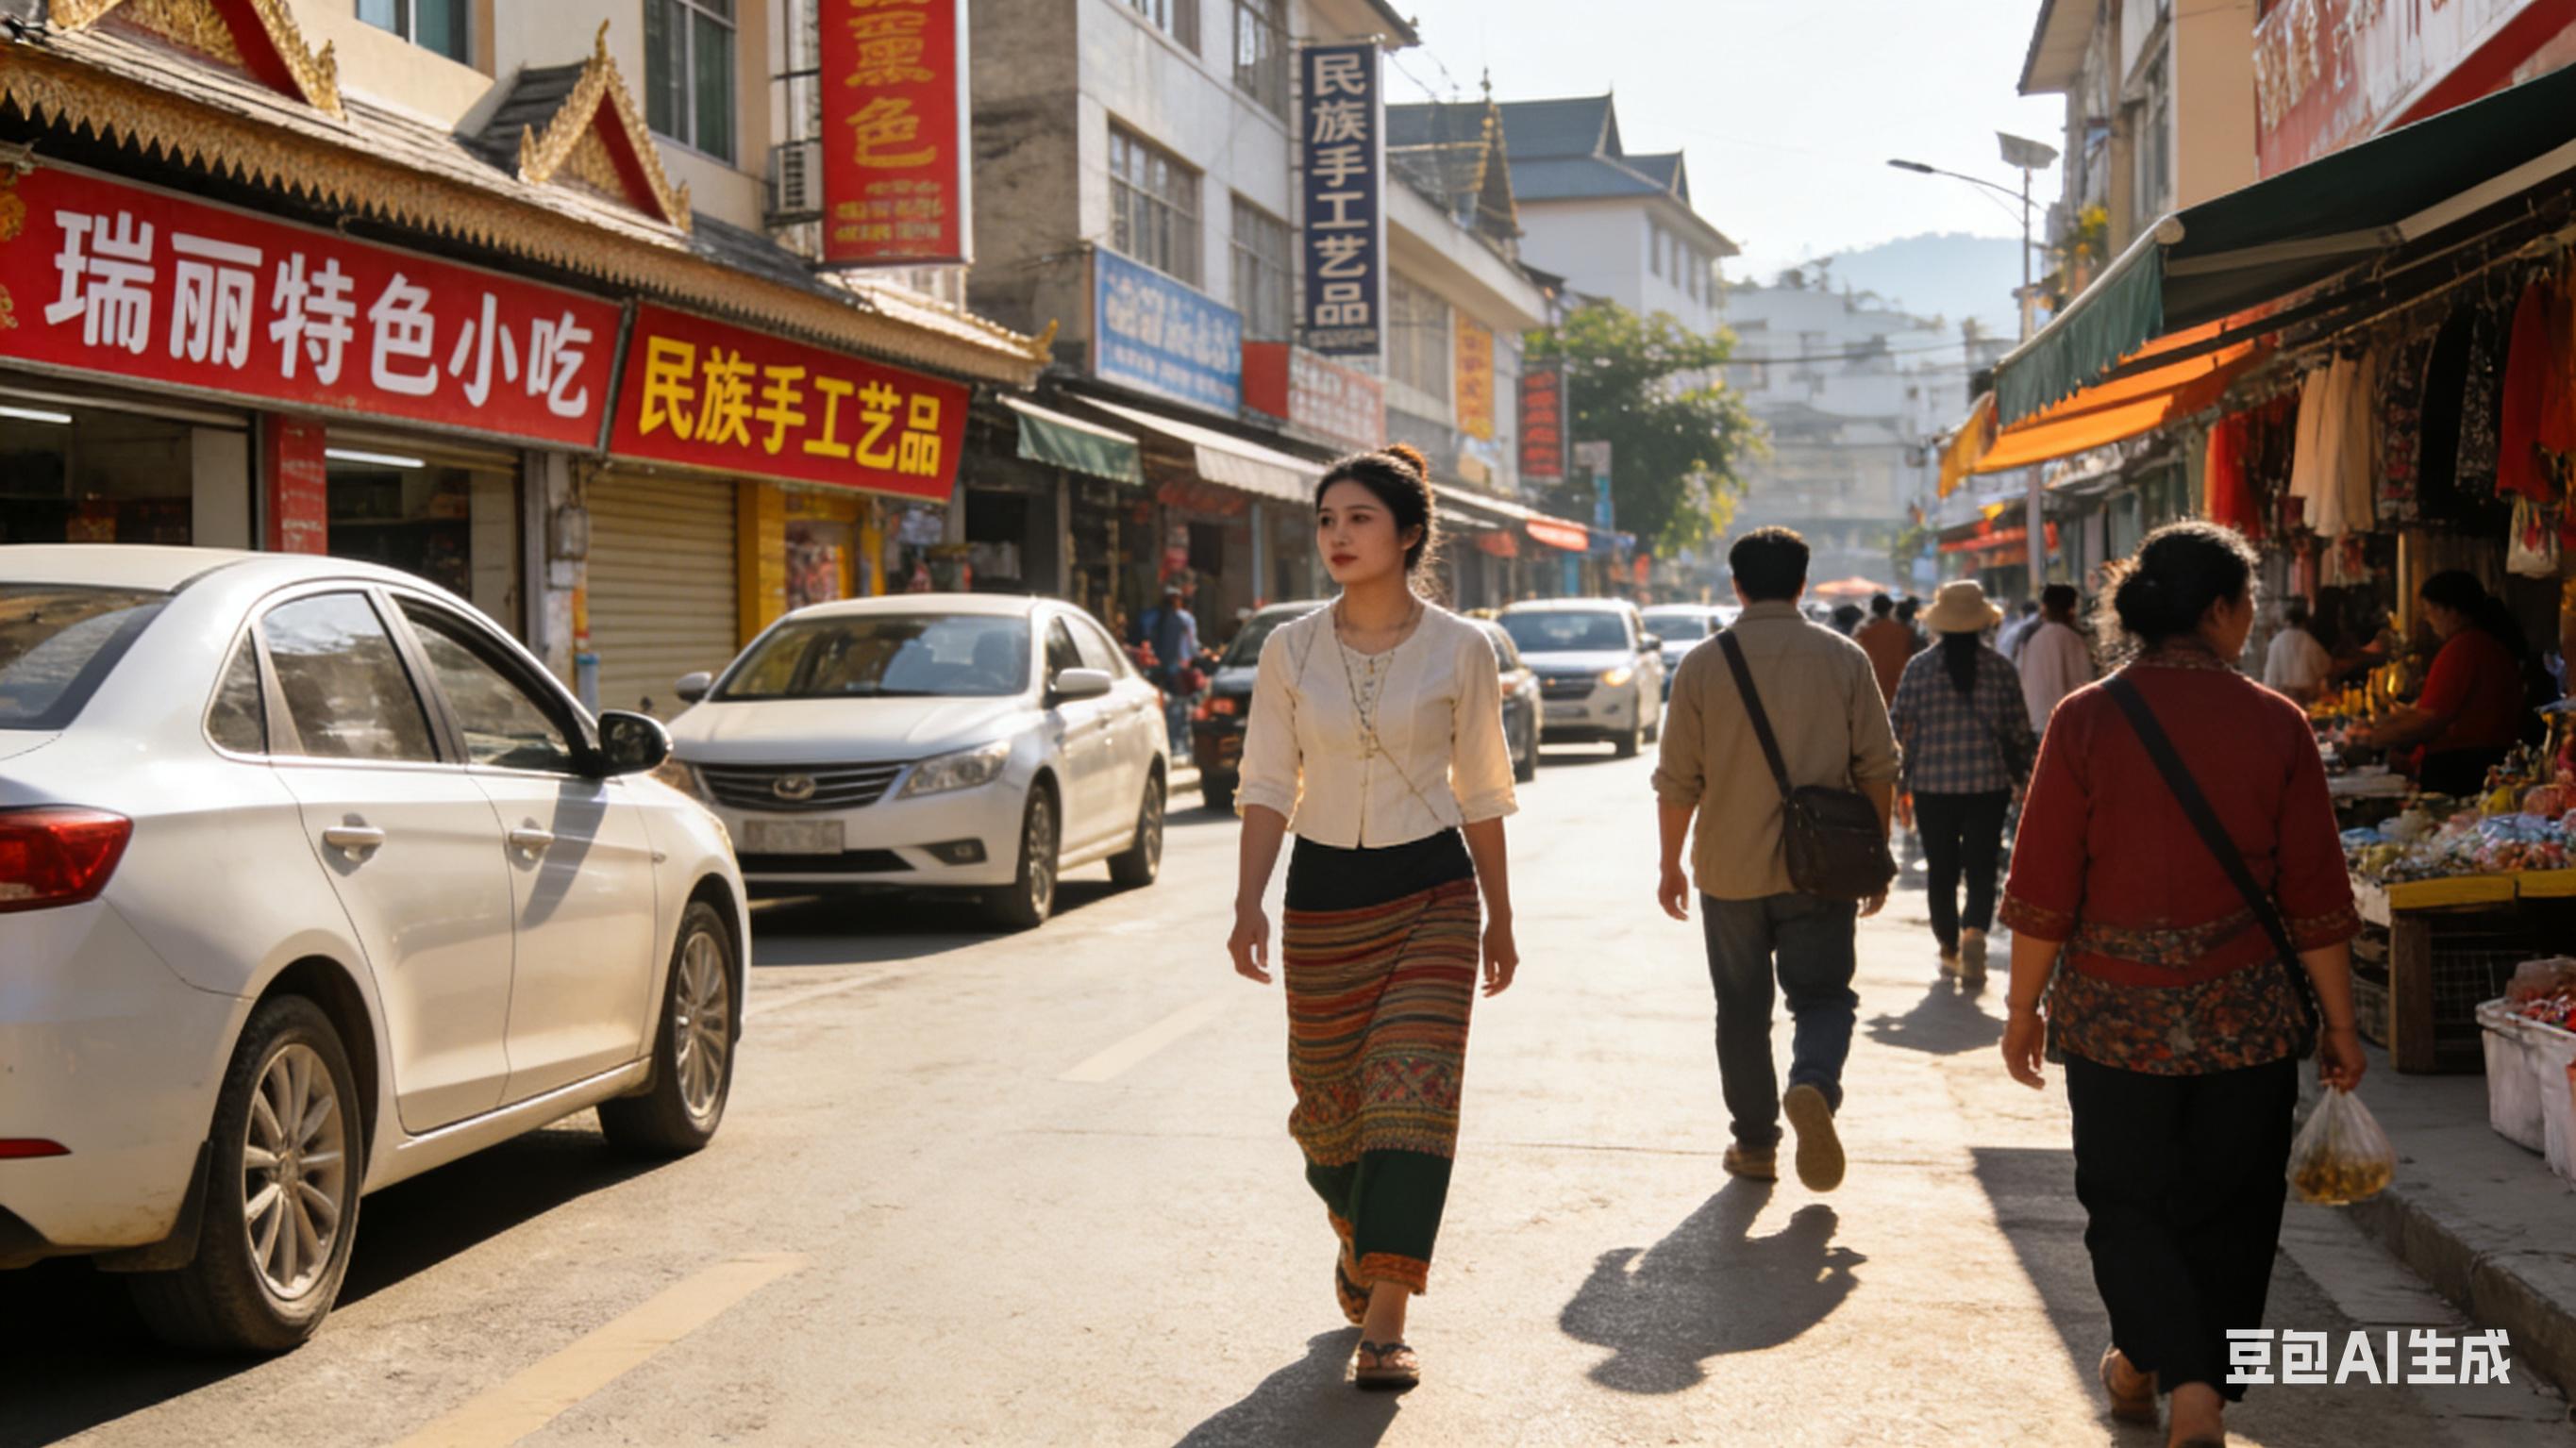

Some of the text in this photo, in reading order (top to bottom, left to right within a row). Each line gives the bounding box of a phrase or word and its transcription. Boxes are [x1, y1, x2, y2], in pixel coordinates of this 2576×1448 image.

[1312, 54, 1369, 326] 民族手工艺品
[44, 209, 594, 419] 瑞丽特色小吃
[639, 335, 942, 477] 民族手工艺品
